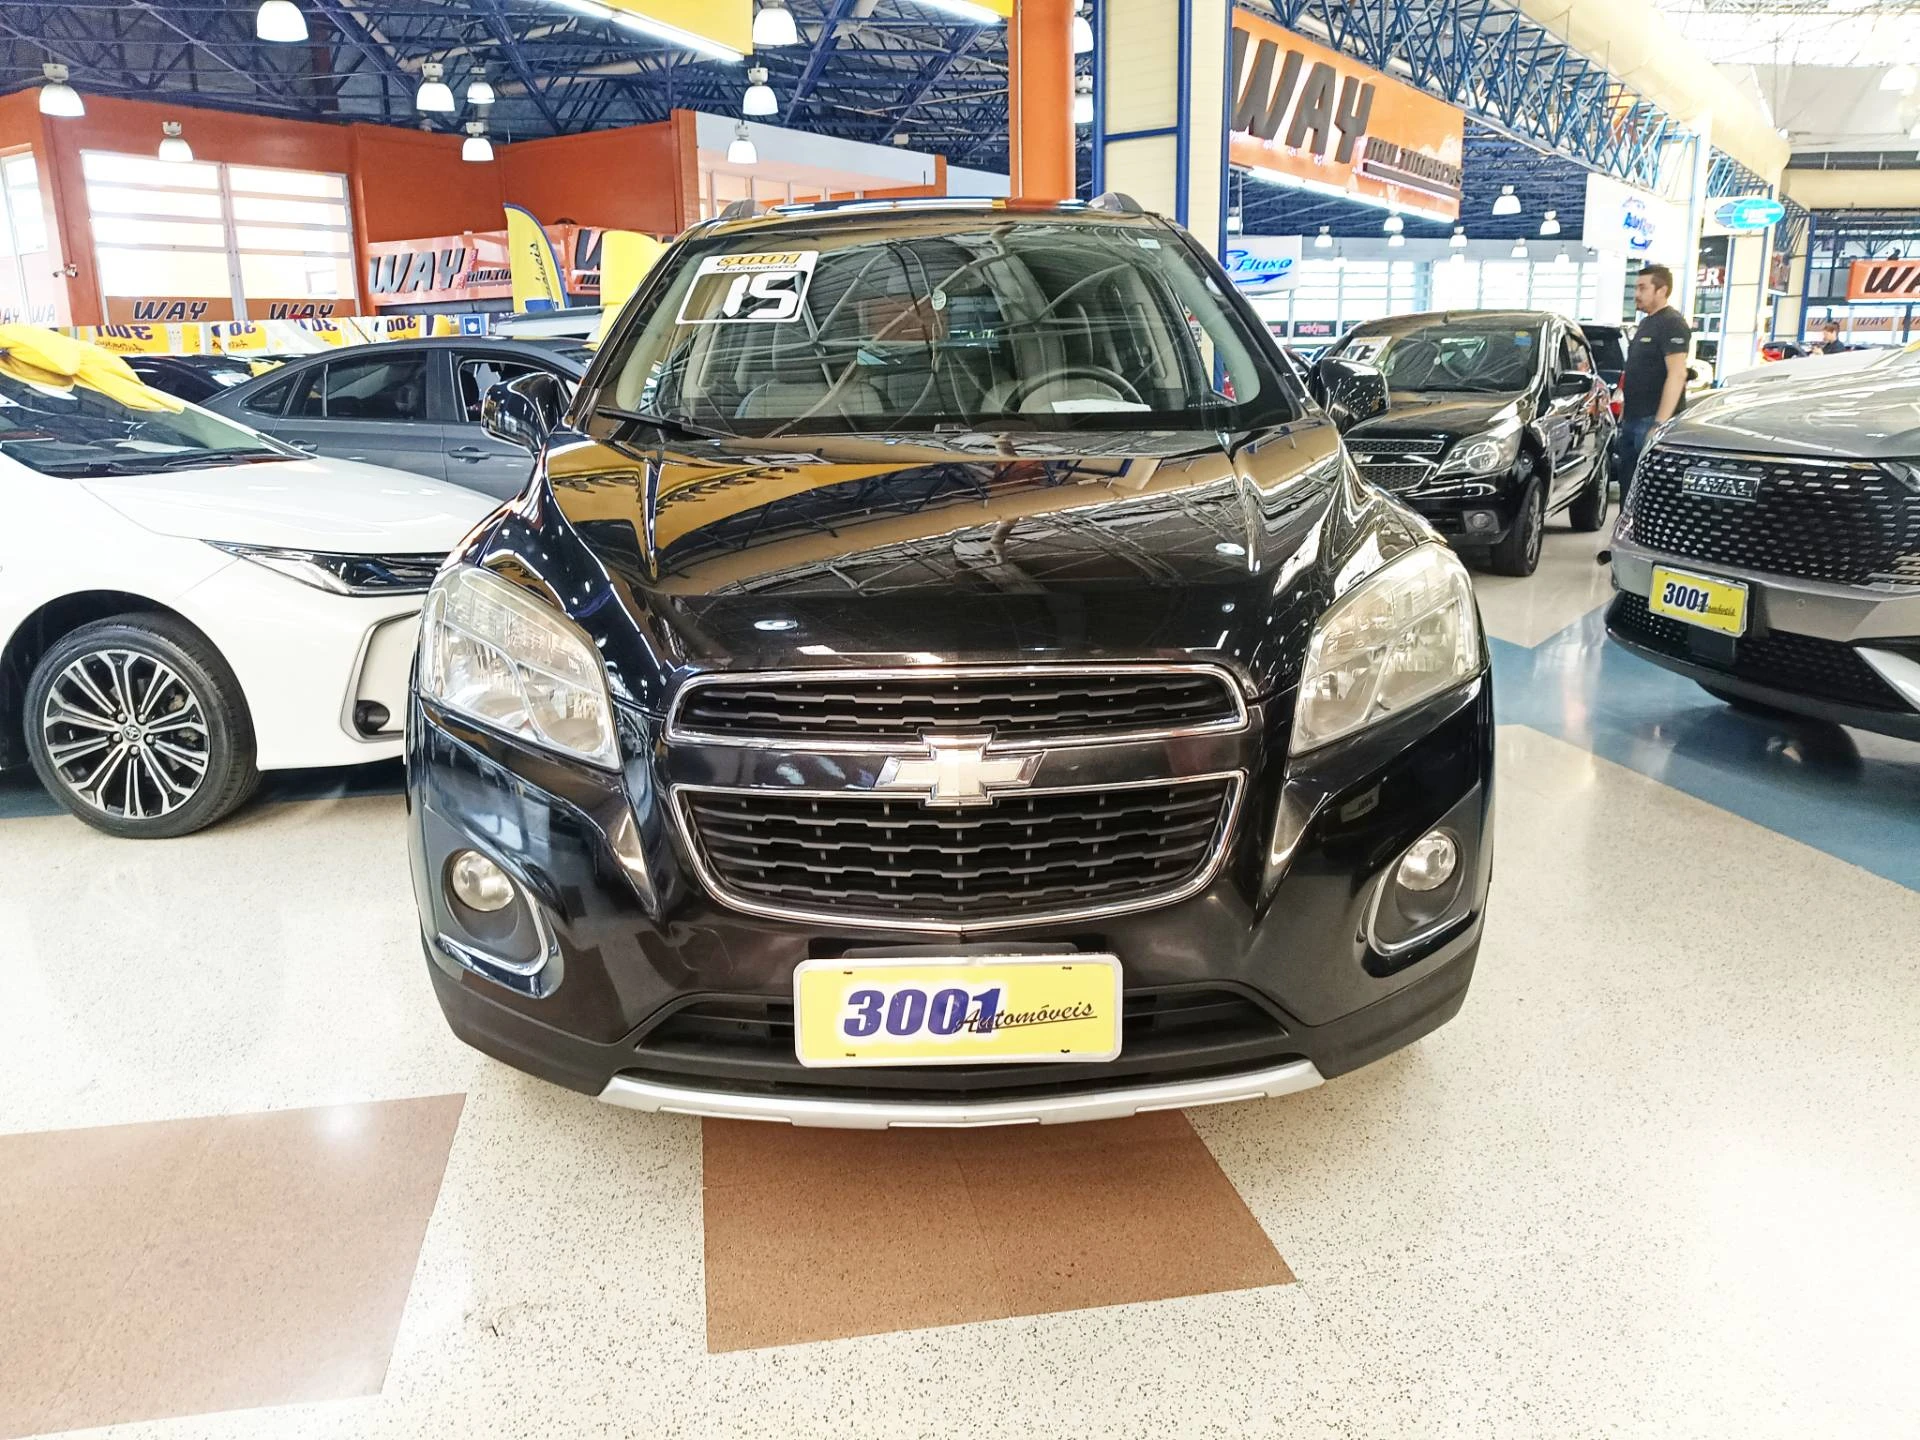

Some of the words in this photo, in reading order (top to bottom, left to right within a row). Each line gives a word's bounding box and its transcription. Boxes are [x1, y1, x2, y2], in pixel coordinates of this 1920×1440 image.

[1231, 26, 1376, 164] WAY
[370, 248, 466, 295] WAY
[717, 253, 802, 267] 3001
[133, 301, 208, 321] WAY
[269, 303, 334, 320] WAY
[722, 273, 800, 319] 15
[1683, 475, 1753, 497] HAVAL
[1663, 582, 1709, 613] 3001
[844, 988, 1001, 1037] 3001
[954, 1001, 1098, 1034] Automóveis
